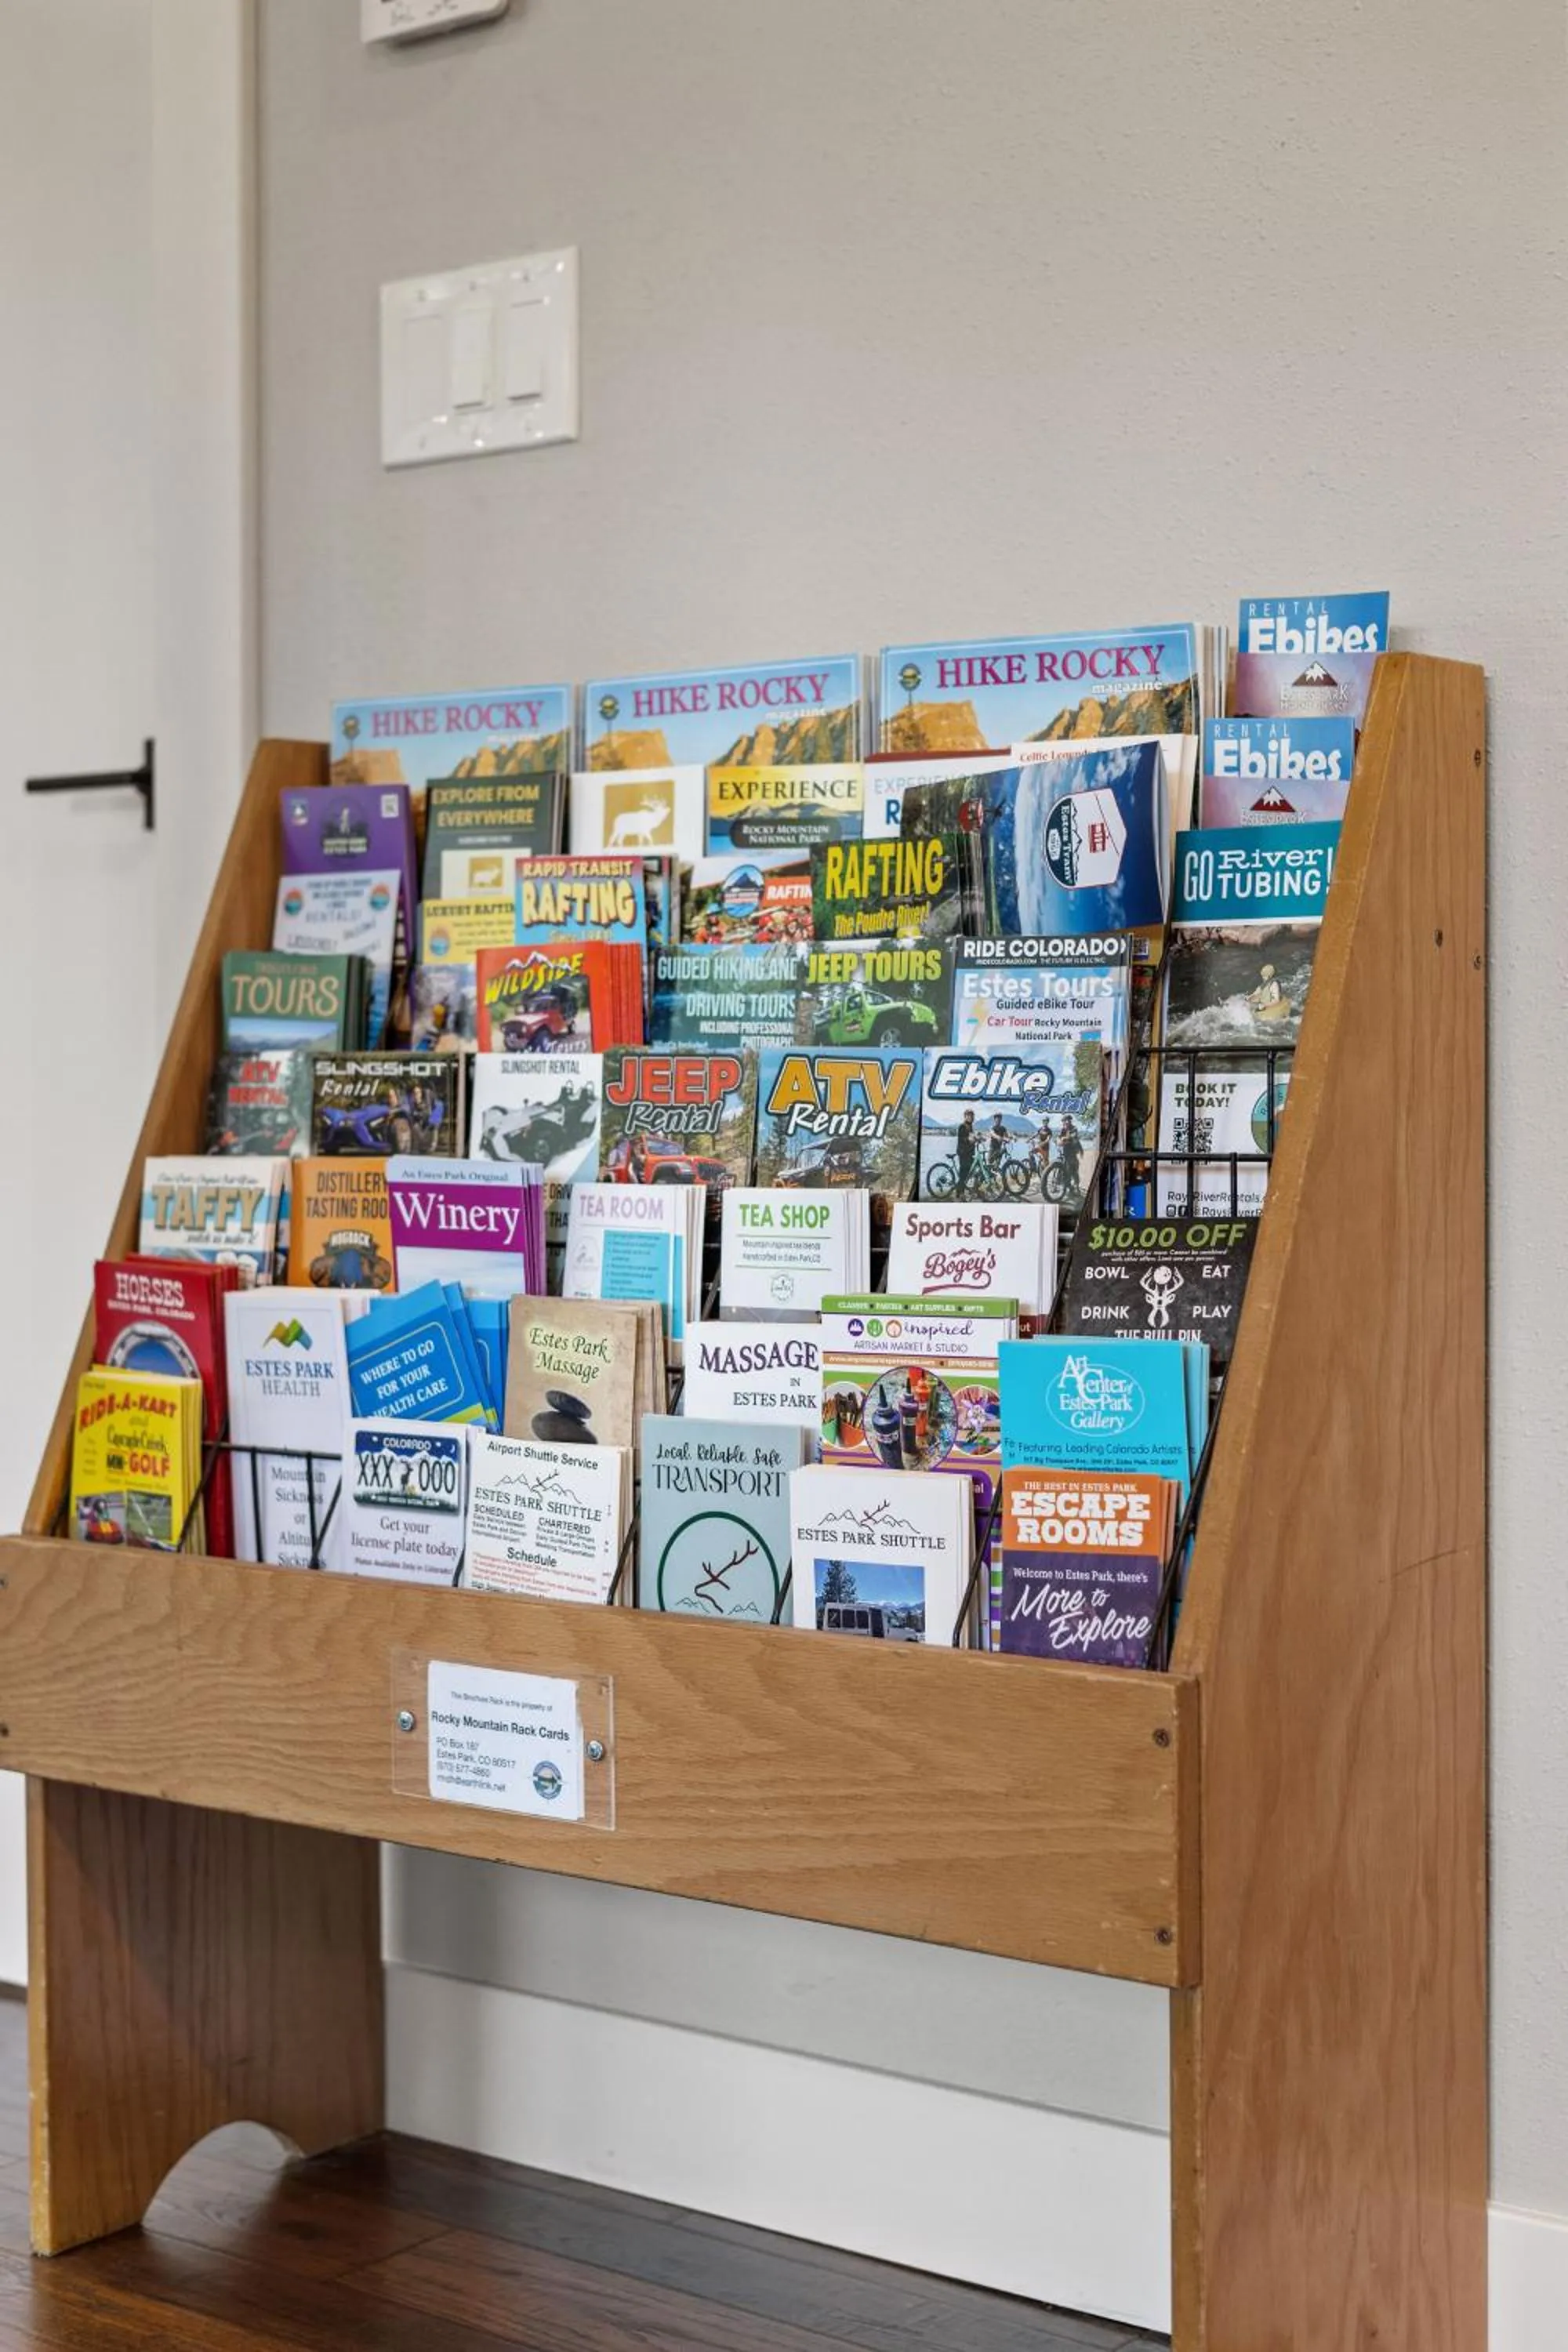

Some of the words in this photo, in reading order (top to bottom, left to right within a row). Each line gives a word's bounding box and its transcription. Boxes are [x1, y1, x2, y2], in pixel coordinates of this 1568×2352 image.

[1249, 601, 1329, 616] RENTAL
[1248, 615, 1379, 652] Ebikes
[936, 654, 1028, 689] HIKE
[1035, 644, 1165, 683] ROCKY
[632, 684, 710, 719] HIKE
[717, 673, 829, 711] ROCKY
[1091, 681, 1163, 695] magazine
[372, 709, 437, 738] HIKE
[445, 700, 545, 733] ROCKY
[1214, 724, 1289, 738] RENTAL
[1214, 737, 1341, 781] Ebikes
[432, 786, 495, 805] EXPLORE
[497, 785, 540, 802] FROM
[719, 779, 857, 800] EXPERIENCE
[437, 808, 535, 828] EVERYWHERE
[742, 825, 775, 836] ROCKY
[777, 825, 829, 835] MOUNTAIN
[749, 834, 797, 844] NATIONAL
[799, 835, 823, 844] PARK
[522, 861, 567, 878] RAPID
[572, 861, 633, 877] TRANSIT
[826, 840, 944, 900] RAFTING
[1184, 850, 1214, 902] GO
[1218, 849, 1323, 870] River
[522, 879, 637, 927] RAFTING
[834, 914, 854, 938] The
[856, 911, 895, 932] Poudre
[896, 901, 930, 931] River!
[964, 940, 1007, 958] RIDE
[1009, 938, 1114, 957] COLORADO
[658, 956, 710, 979] GUIDED
[713, 956, 764, 980] HIKING
[806, 953, 858, 984] JEEP
[863, 949, 942, 982] TOURS
[485, 953, 583, 1005] WILDSIDE
[963, 973, 1033, 998] Estes
[1039, 972, 1113, 997] Tours
[230, 975, 339, 1017] TOURS
[686, 993, 745, 1017] DRIVING
[751, 993, 796, 1018] TOURS
[996, 999, 1034, 1010] Guided
[1037, 999, 1067, 1010] eBike
[1070, 998, 1094, 1009] Tour
[987, 1016, 1005, 1026] Car
[1008, 1016, 1033, 1026] Tour
[1035, 1019, 1060, 1029] Rocky
[1015, 1030, 1051, 1041] National
[1053, 1030, 1072, 1040] Park
[239, 1061, 282, 1082] ATV
[315, 1061, 448, 1076] SLINGSHOT
[501, 1060, 547, 1074] SLINGSHOT
[550, 1060, 581, 1074] RENTAL
[935, 1059, 1051, 1098] Ebike
[320, 1079, 379, 1097] Rental
[606, 1057, 742, 1106] JEEP
[768, 1055, 915, 1116] ATV
[1221, 1083, 1237, 1093] IT
[1019, 1091, 1091, 1115] Rental
[625, 1102, 724, 1134] Rental
[786, 1103, 890, 1138] Rental
[150, 1185, 266, 1231] TAFFY
[307, 1196, 358, 1218] TASTING
[393, 1191, 521, 1245] Winery
[579, 1195, 606, 1218] TEA
[609, 1196, 664, 1221] ROOM
[739, 1203, 774, 1228] TEA
[780, 1204, 831, 1229] SHOP
[906, 1213, 973, 1243] Sports
[979, 1214, 1022, 1240] Bar
[1088, 1224, 1177, 1250] $10.00
[1185, 1223, 1247, 1247] OFF
[922, 1248, 996, 1283] Bogey's
[1085, 1266, 1130, 1279] BOWL
[1202, 1265, 1232, 1278] EAT
[114, 1272, 185, 1308] HORSES
[1081, 1306, 1131, 1319] DRINK
[1192, 1305, 1232, 1318] PLAY
[904, 1319, 974, 1340] inspired
[529, 1327, 569, 1352] Estes
[572, 1334, 611, 1363] Park
[699, 1339, 819, 1374] MASSAGE
[854, 1341, 887, 1350] ARTISAN
[890, 1341, 923, 1352] MARKET
[926, 1343, 931, 1352] &
[935, 1343, 968, 1353] STUDIO
[245, 1360, 292, 1378] ESTES
[296, 1361, 334, 1380] PARK
[360, 1357, 401, 1385] WHERE
[401, 1350, 417, 1368] TO
[418, 1339, 436, 1359] GO
[535, 1351, 601, 1384] Massage
[261, 1379, 321, 1398] HEALTH
[376, 1380, 401, 1400] FOR
[400, 1366, 432, 1388] YOUR
[416, 1377, 449, 1403] CARE
[790, 1377, 801, 1388] IN
[733, 1392, 777, 1407] ESTES
[779, 1393, 818, 1409] PARK
[1100, 1393, 1133, 1410] Park
[1070, 1411, 1125, 1430] Gallery
[383, 1436, 431, 1450] COLORADO
[487, 1439, 522, 1456] Airport
[524, 1446, 559, 1463] Shuttle
[561, 1453, 599, 1471] Service
[1065, 1443, 1105, 1456] Leading
[1106, 1443, 1150, 1454] Colorado
[129, 1452, 169, 1479] GOLF
[358, 1454, 394, 1488] XXX
[652, 1464, 786, 1497] TRANSPORT
[1024, 1481, 1042, 1490] THE
[1112, 1483, 1137, 1493] PARK
[474, 1487, 510, 1505] ESTES
[514, 1493, 543, 1511] PARK
[546, 1501, 603, 1523] SHUTTLE
[474, 1504, 524, 1522] SCHEDULED
[1011, 1492, 1152, 1520] ESCAPE
[293, 1513, 306, 1525] or
[380, 1515, 400, 1531] Get
[403, 1521, 430, 1535] your
[538, 1517, 591, 1534] CHARTERED
[797, 1527, 839, 1544] ESTES
[842, 1530, 876, 1546] PARK
[880, 1533, 946, 1551] SHUTTLE
[1016, 1519, 1145, 1547] ROOMS
[394, 1537, 423, 1554] plate
[426, 1541, 459, 1561] today
[506, 1547, 557, 1568] Schedule
[1012, 1567, 1053, 1580] Welcome
[1055, 1569, 1064, 1580] to
[1065, 1570, 1090, 1581] Estes
[1091, 1570, 1116, 1584] Park,
[1116, 1570, 1149, 1584] there's
[1011, 1583, 1087, 1623] More
[1091, 1588, 1111, 1607] to
[1048, 1609, 1152, 1654] Explore
[431, 1711, 460, 1727] Rocky
[463, 1715, 508, 1732] Mountain
[510, 1722, 535, 1736] Rack
[539, 1726, 570, 1741] Cards
[450, 1738, 464, 1749] Box
[437, 1749, 456, 1759] Estes
[477, 1755, 492, 1765] CO
[492, 1757, 516, 1769] 80517
